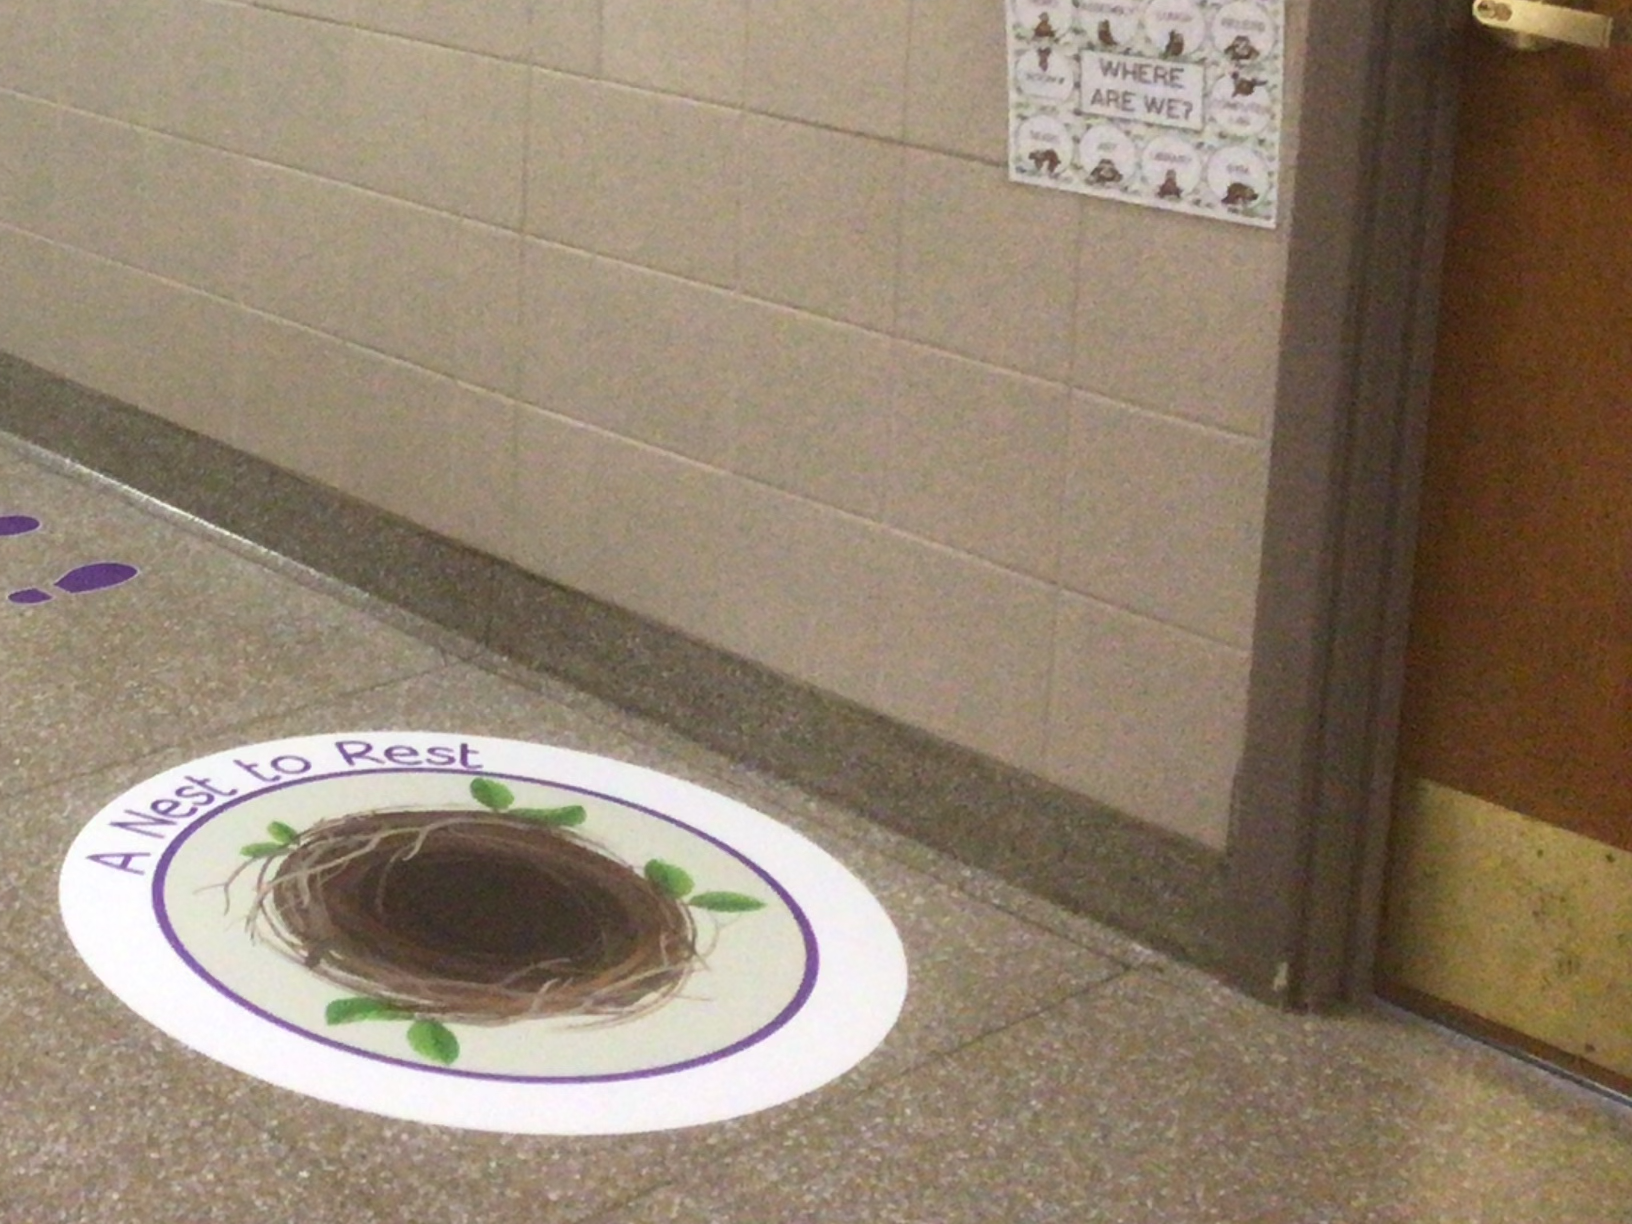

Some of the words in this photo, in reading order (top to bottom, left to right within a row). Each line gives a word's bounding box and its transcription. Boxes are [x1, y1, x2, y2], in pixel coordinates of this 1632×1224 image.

[1099, 57, 1185, 89] WHERE
[1090, 88, 1136, 112] ARE
[1144, 95, 1193, 120] WE?
[233, 754, 312, 783] to
[334, 740, 483, 770] Rest
[108, 774, 239, 839] Nest
[86, 850, 151, 876] A
